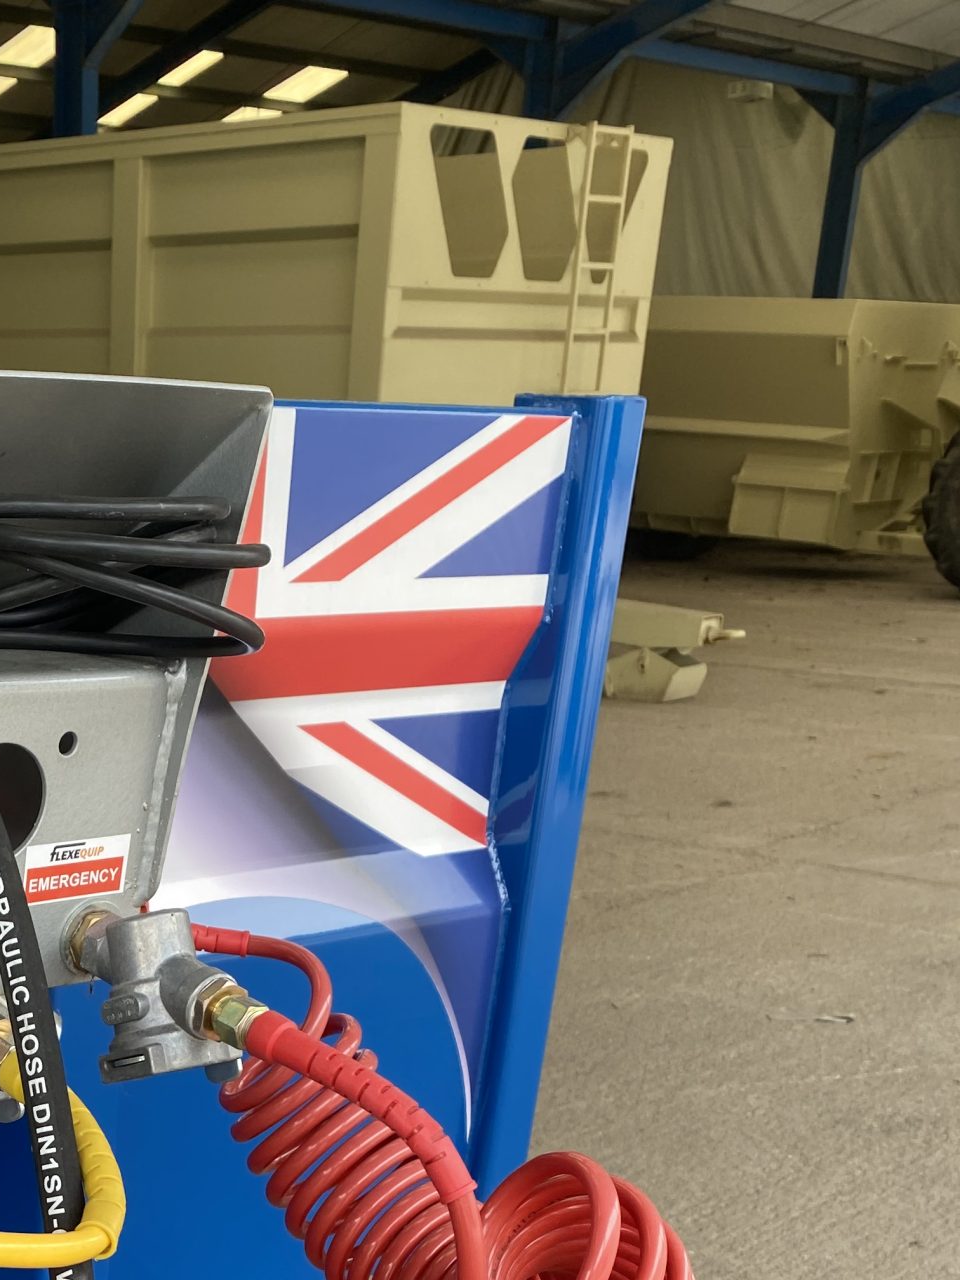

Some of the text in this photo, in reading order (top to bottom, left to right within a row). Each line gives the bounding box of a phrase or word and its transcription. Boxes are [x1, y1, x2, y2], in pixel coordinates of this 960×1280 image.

[28, 866, 120, 894] EMERGENCY
[16, 1012, 48, 1097] HOSE
[32, 1103, 69, 1234] DIN1SN-
